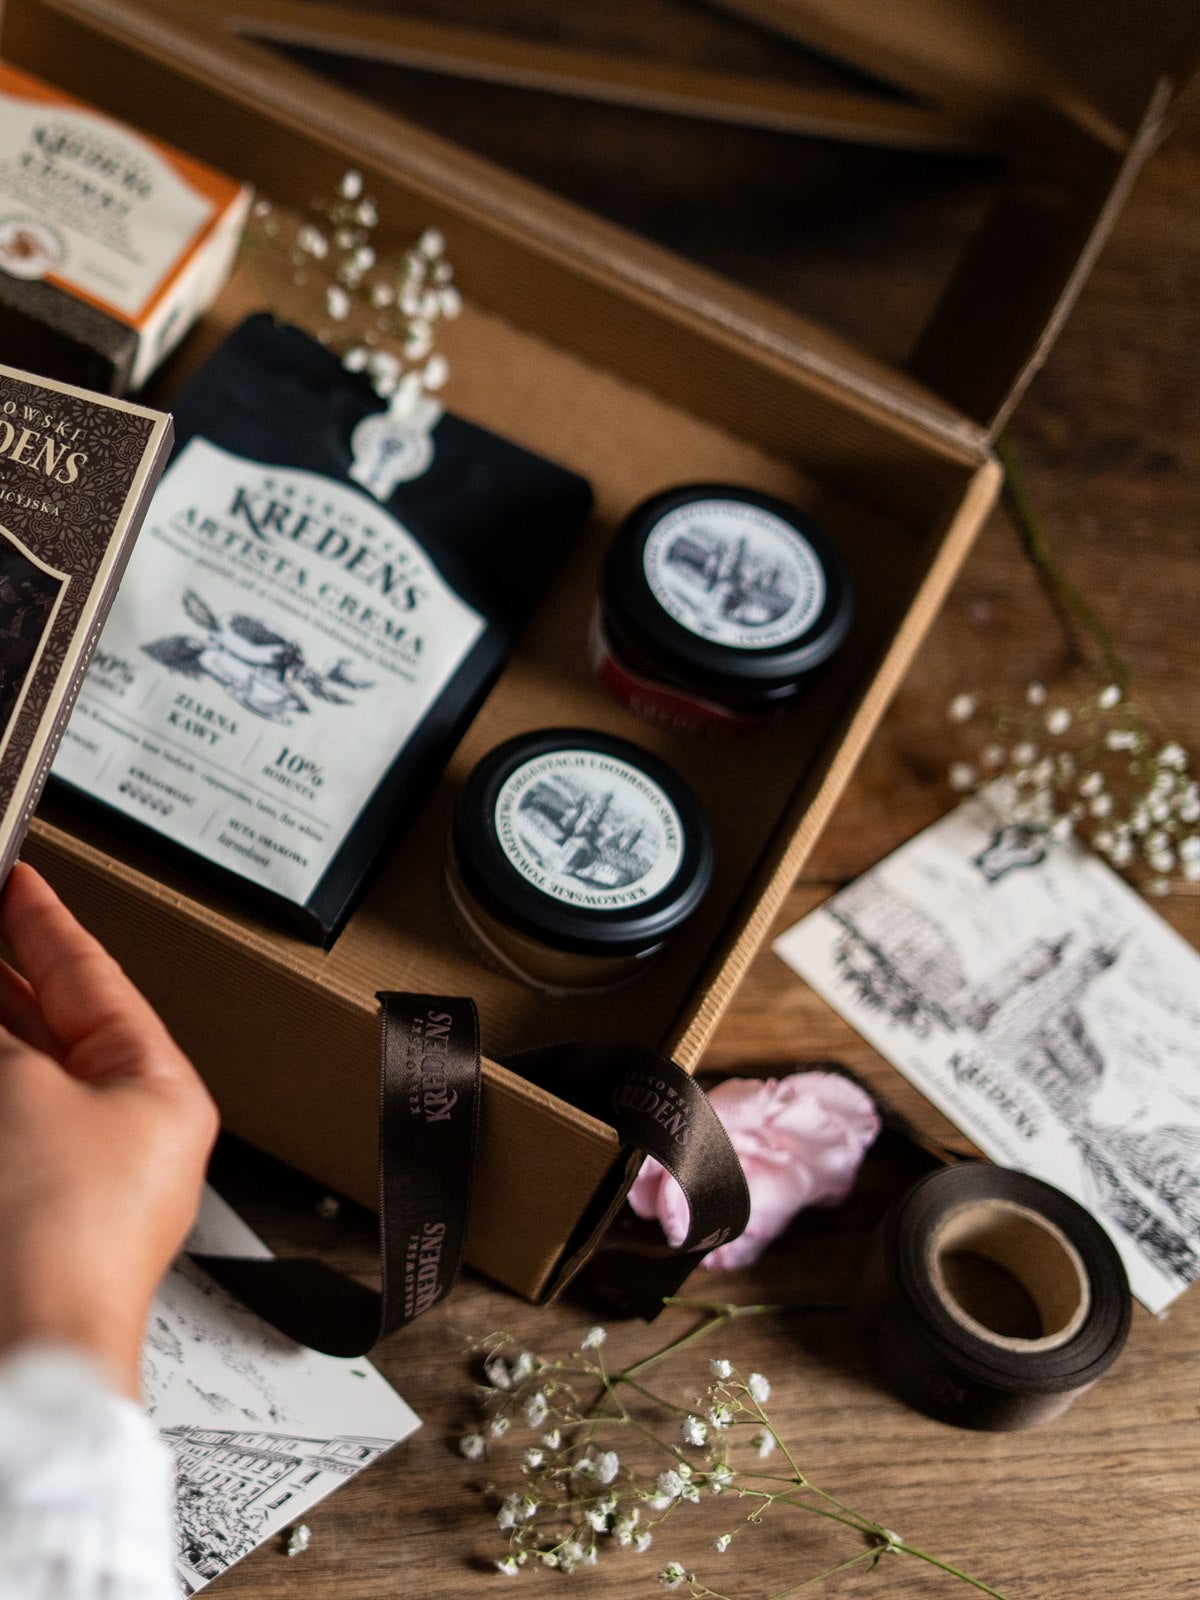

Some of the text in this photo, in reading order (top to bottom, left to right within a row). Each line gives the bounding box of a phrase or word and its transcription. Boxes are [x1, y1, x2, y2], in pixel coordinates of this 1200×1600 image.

[229, 485, 430, 613] KREDENS
[181, 506, 308, 588] ARTISTA
[318, 583, 424, 655] CREMA
[167, 709, 221, 746] KAWY
[174, 691, 238, 736] ZIARNA
[275, 745, 324, 788] 10%
[229, 818, 308, 867] NUTA SMAKOWA
[548, 883, 648, 907] KRAKOWSKIE
[421, 1010, 458, 1123] KREDENS
[404, 1234, 420, 1317] KRAKOWSKI
